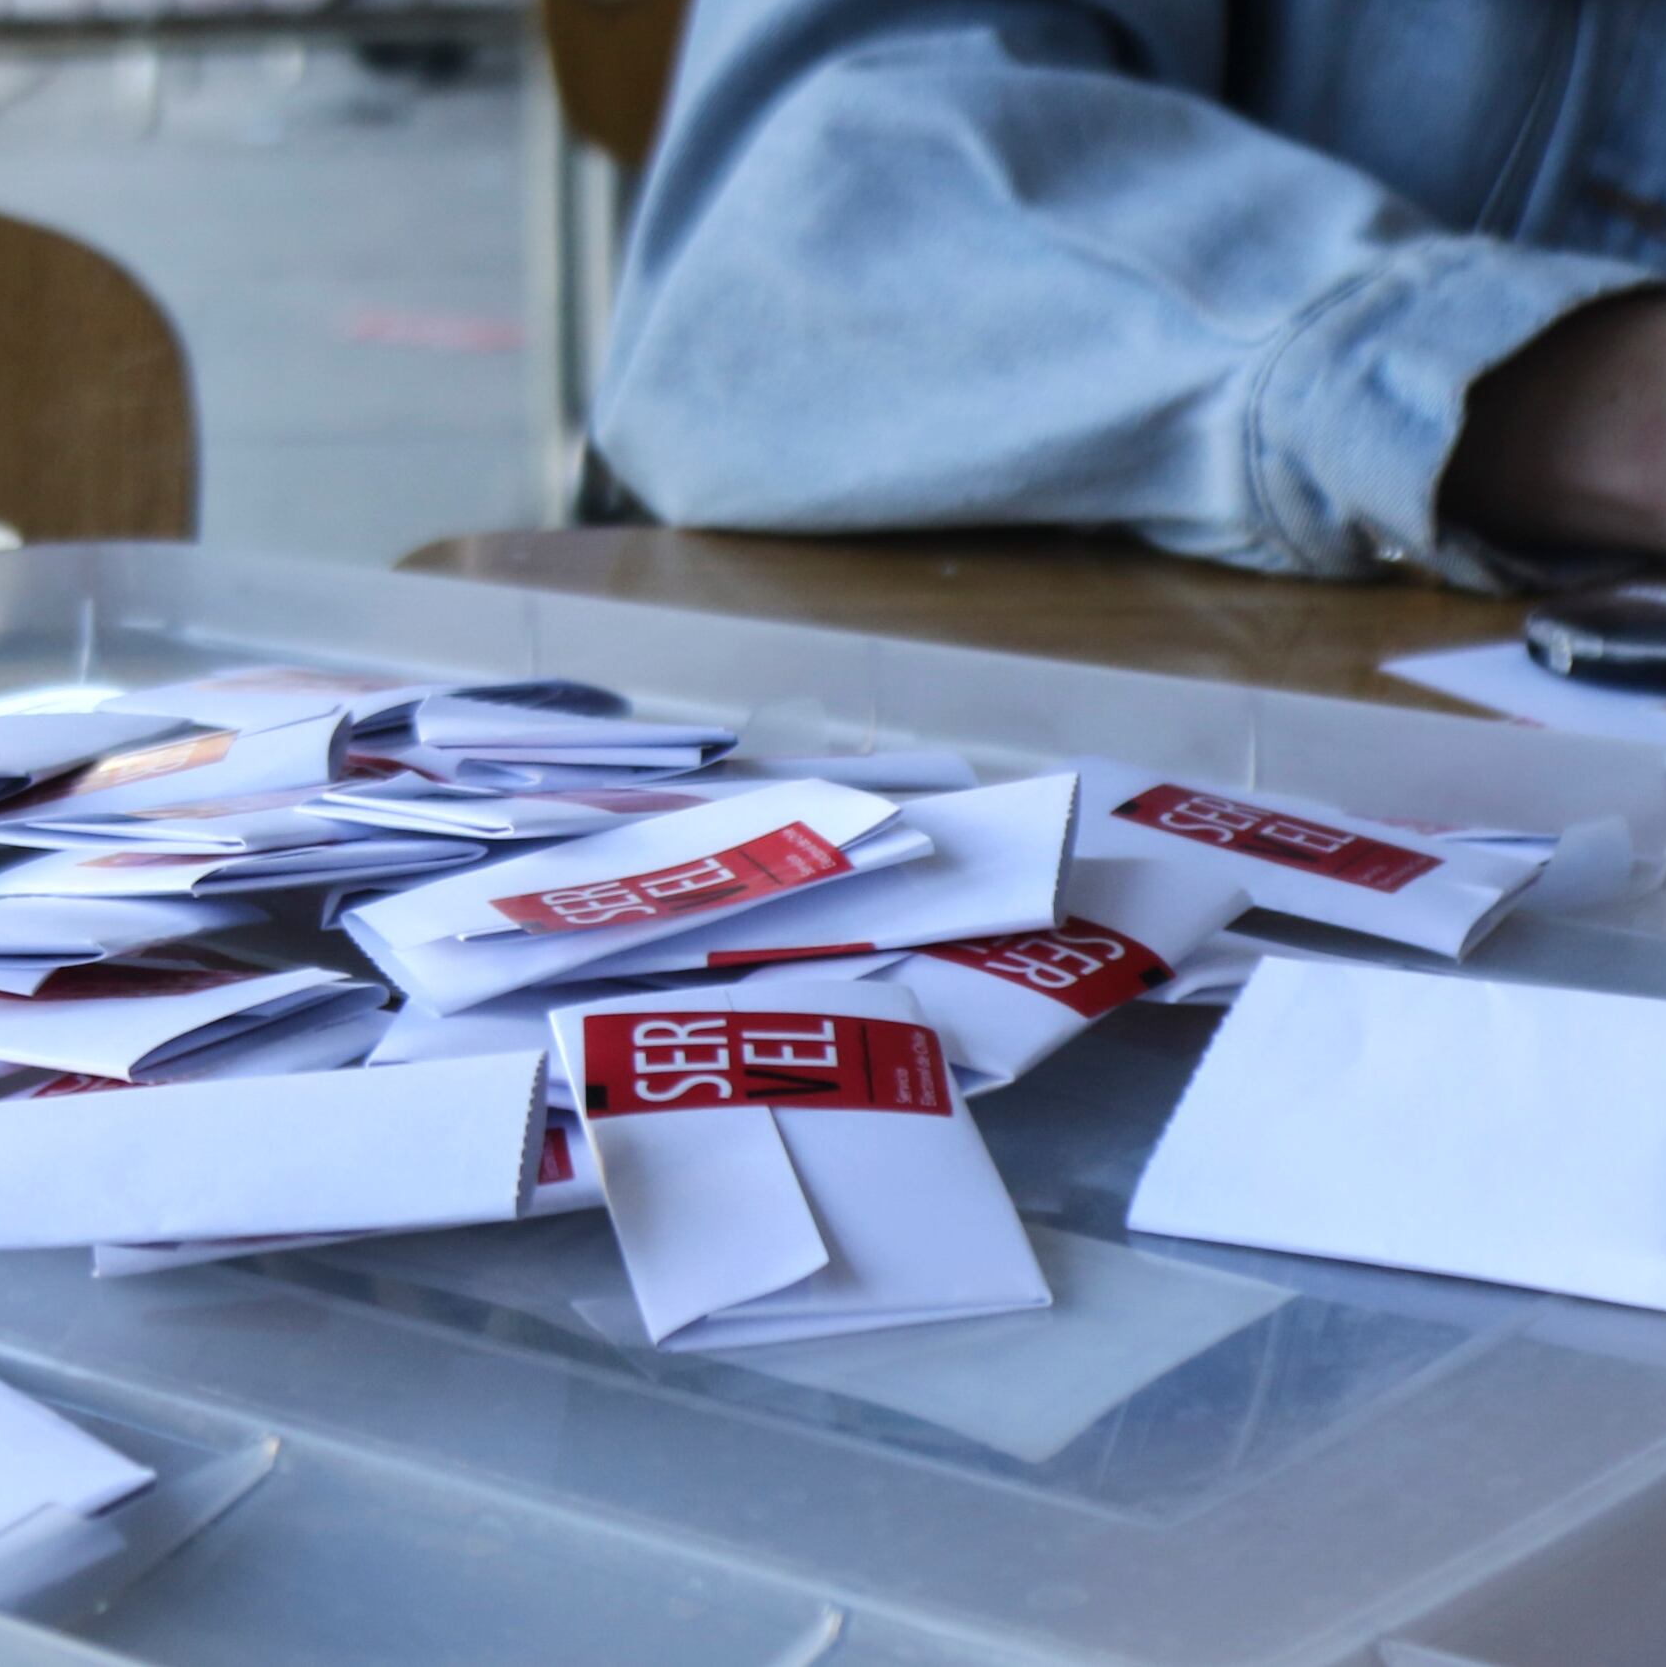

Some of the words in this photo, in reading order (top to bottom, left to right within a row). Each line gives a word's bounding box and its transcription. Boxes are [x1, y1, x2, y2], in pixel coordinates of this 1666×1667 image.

[1160, 795, 1274, 844] SER
[540, 882, 657, 925] SER
[639, 857, 749, 911] VEL
[633, 1018, 733, 1103] SER
[741, 1020, 840, 1098] VEL
